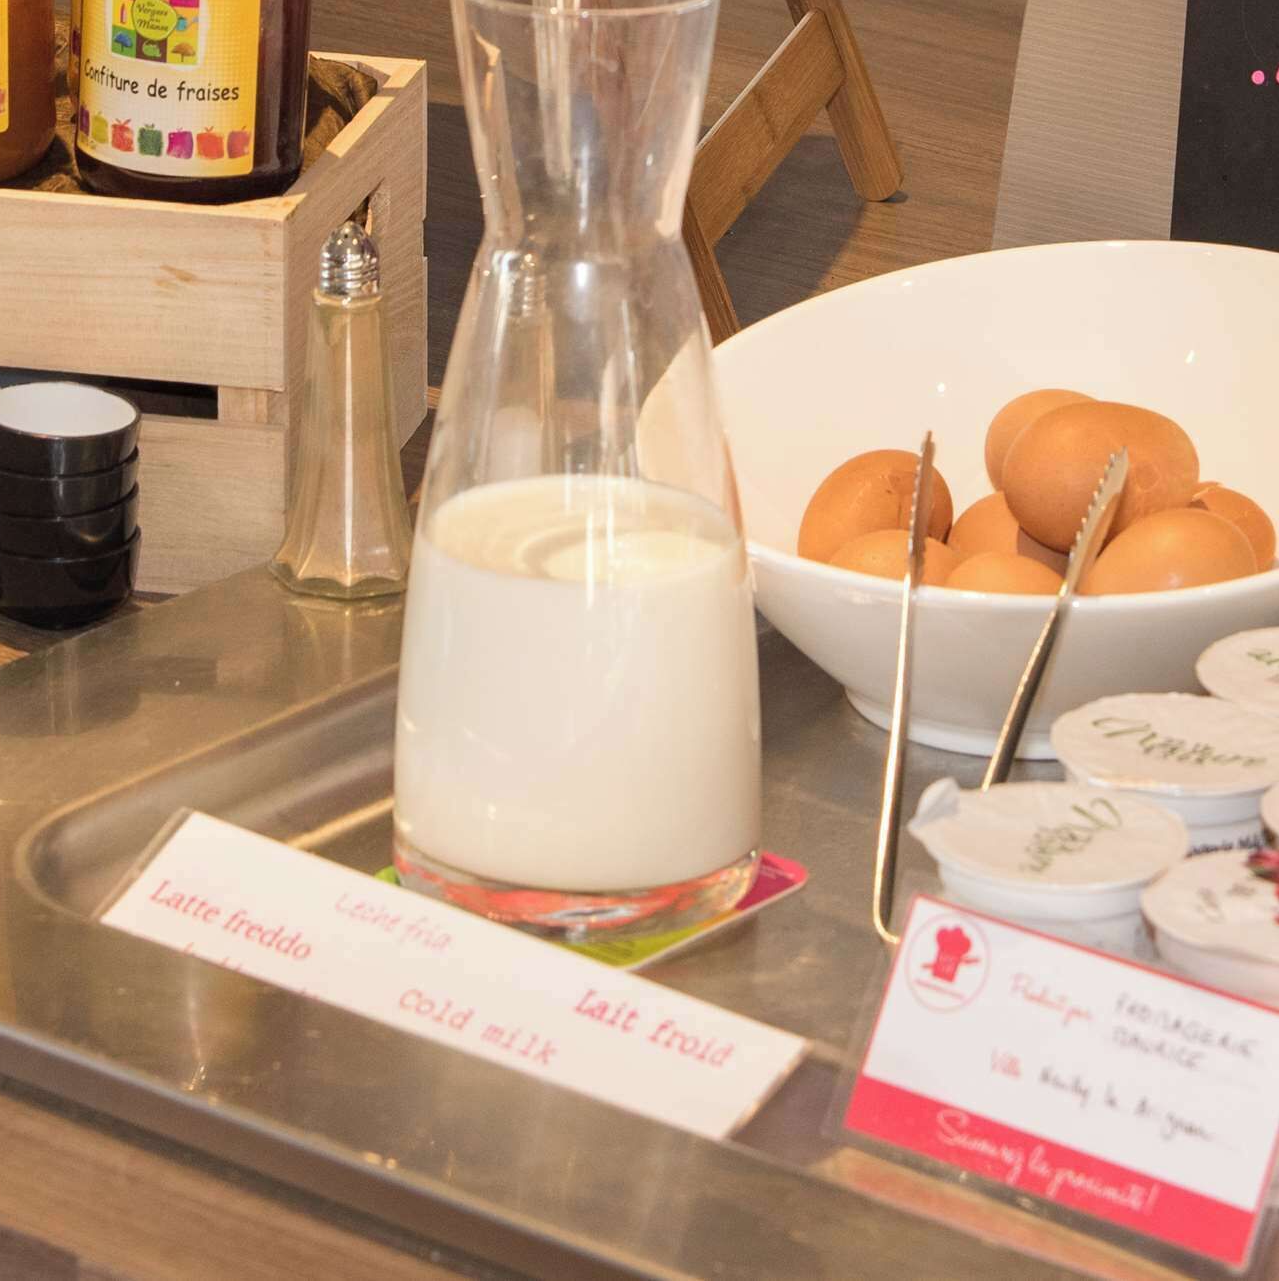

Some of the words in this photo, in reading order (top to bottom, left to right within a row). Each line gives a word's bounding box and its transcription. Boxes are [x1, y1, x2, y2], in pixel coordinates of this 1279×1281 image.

[84, 58, 139, 95] Confiture
[147, 78, 168, 99] de
[177, 79, 240, 102] fraises
[149, 879, 222, 926] Latte
[222, 908, 313, 961] freddo
[479, 1017, 558, 1068] milk
[573, 987, 640, 1036] Lait
[647, 1012, 735, 1070] froid
